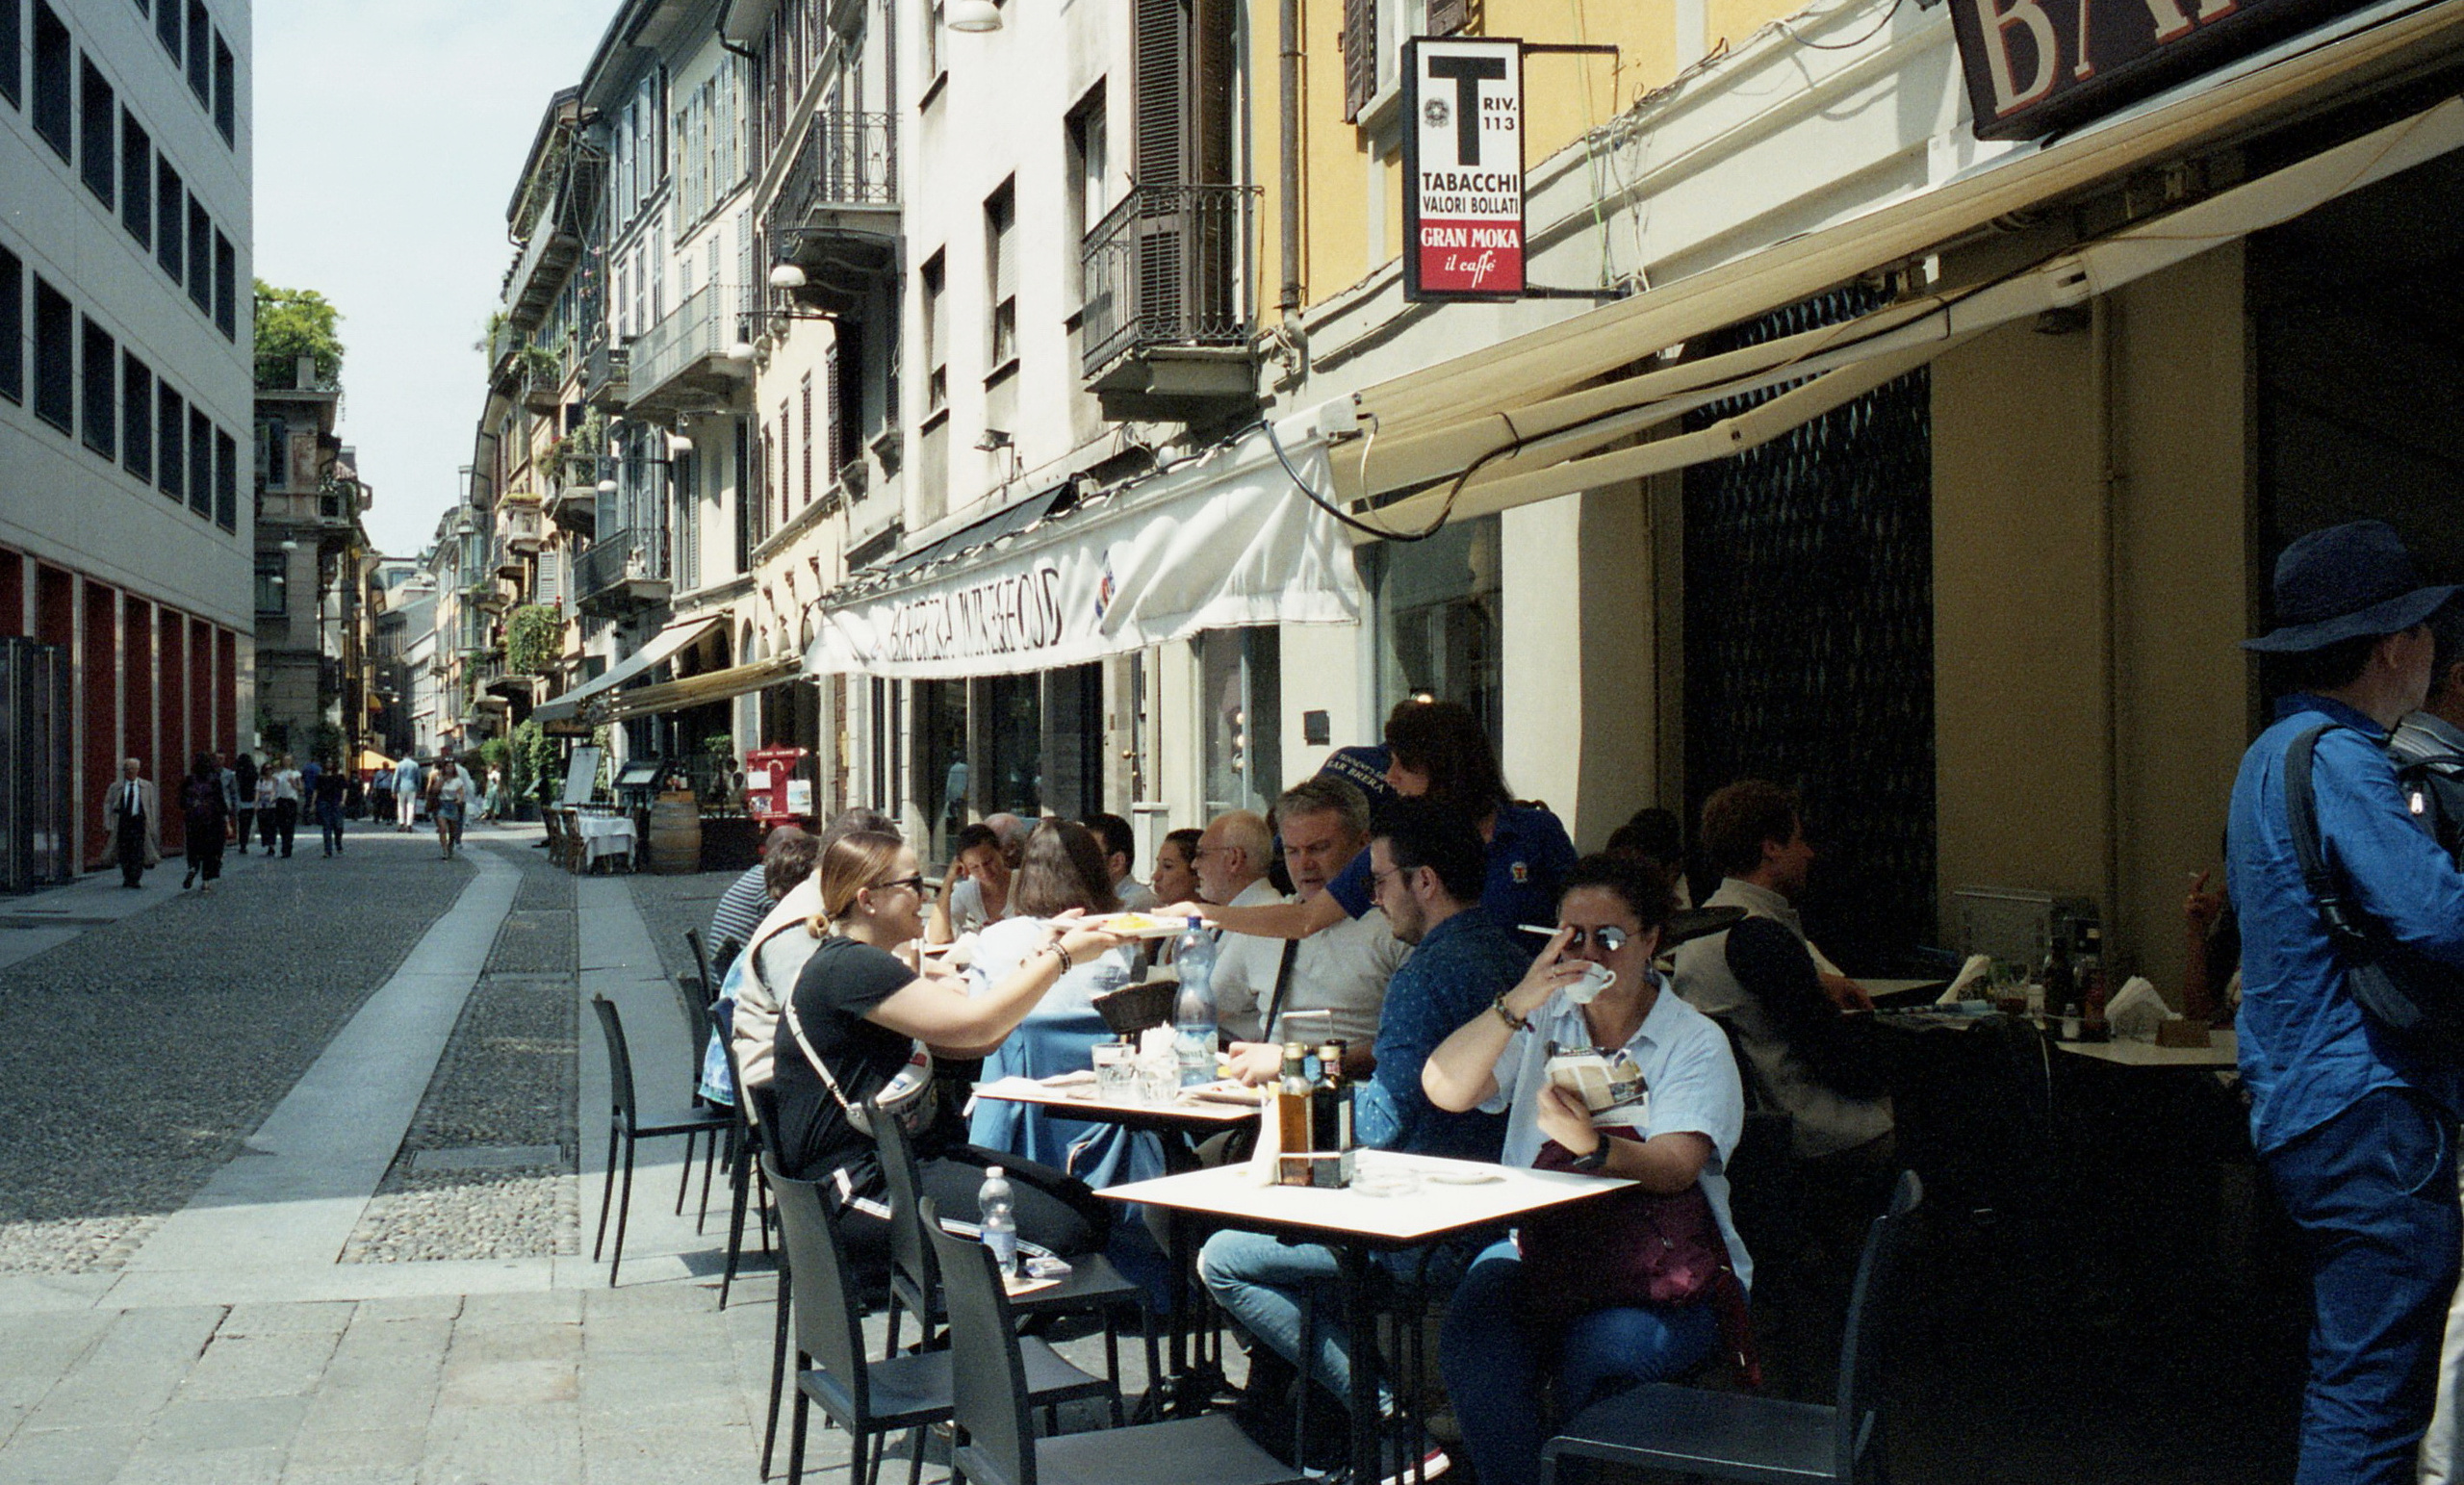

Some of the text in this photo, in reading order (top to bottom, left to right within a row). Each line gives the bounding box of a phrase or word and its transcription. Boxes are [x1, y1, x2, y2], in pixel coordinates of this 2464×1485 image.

[1428, 56, 1506, 166] T
[1483, 97, 1517, 112] RIV.
[1483, 117, 1515, 131] 113
[1423, 172, 1518, 192] TABACCHI
[1423, 195, 1518, 215] VALORI BOLLATI
[1421, 227, 1520, 248] GRAN MOKA
[1445, 254, 1455, 271] il
[1348, 768, 1384, 794] BRERA
